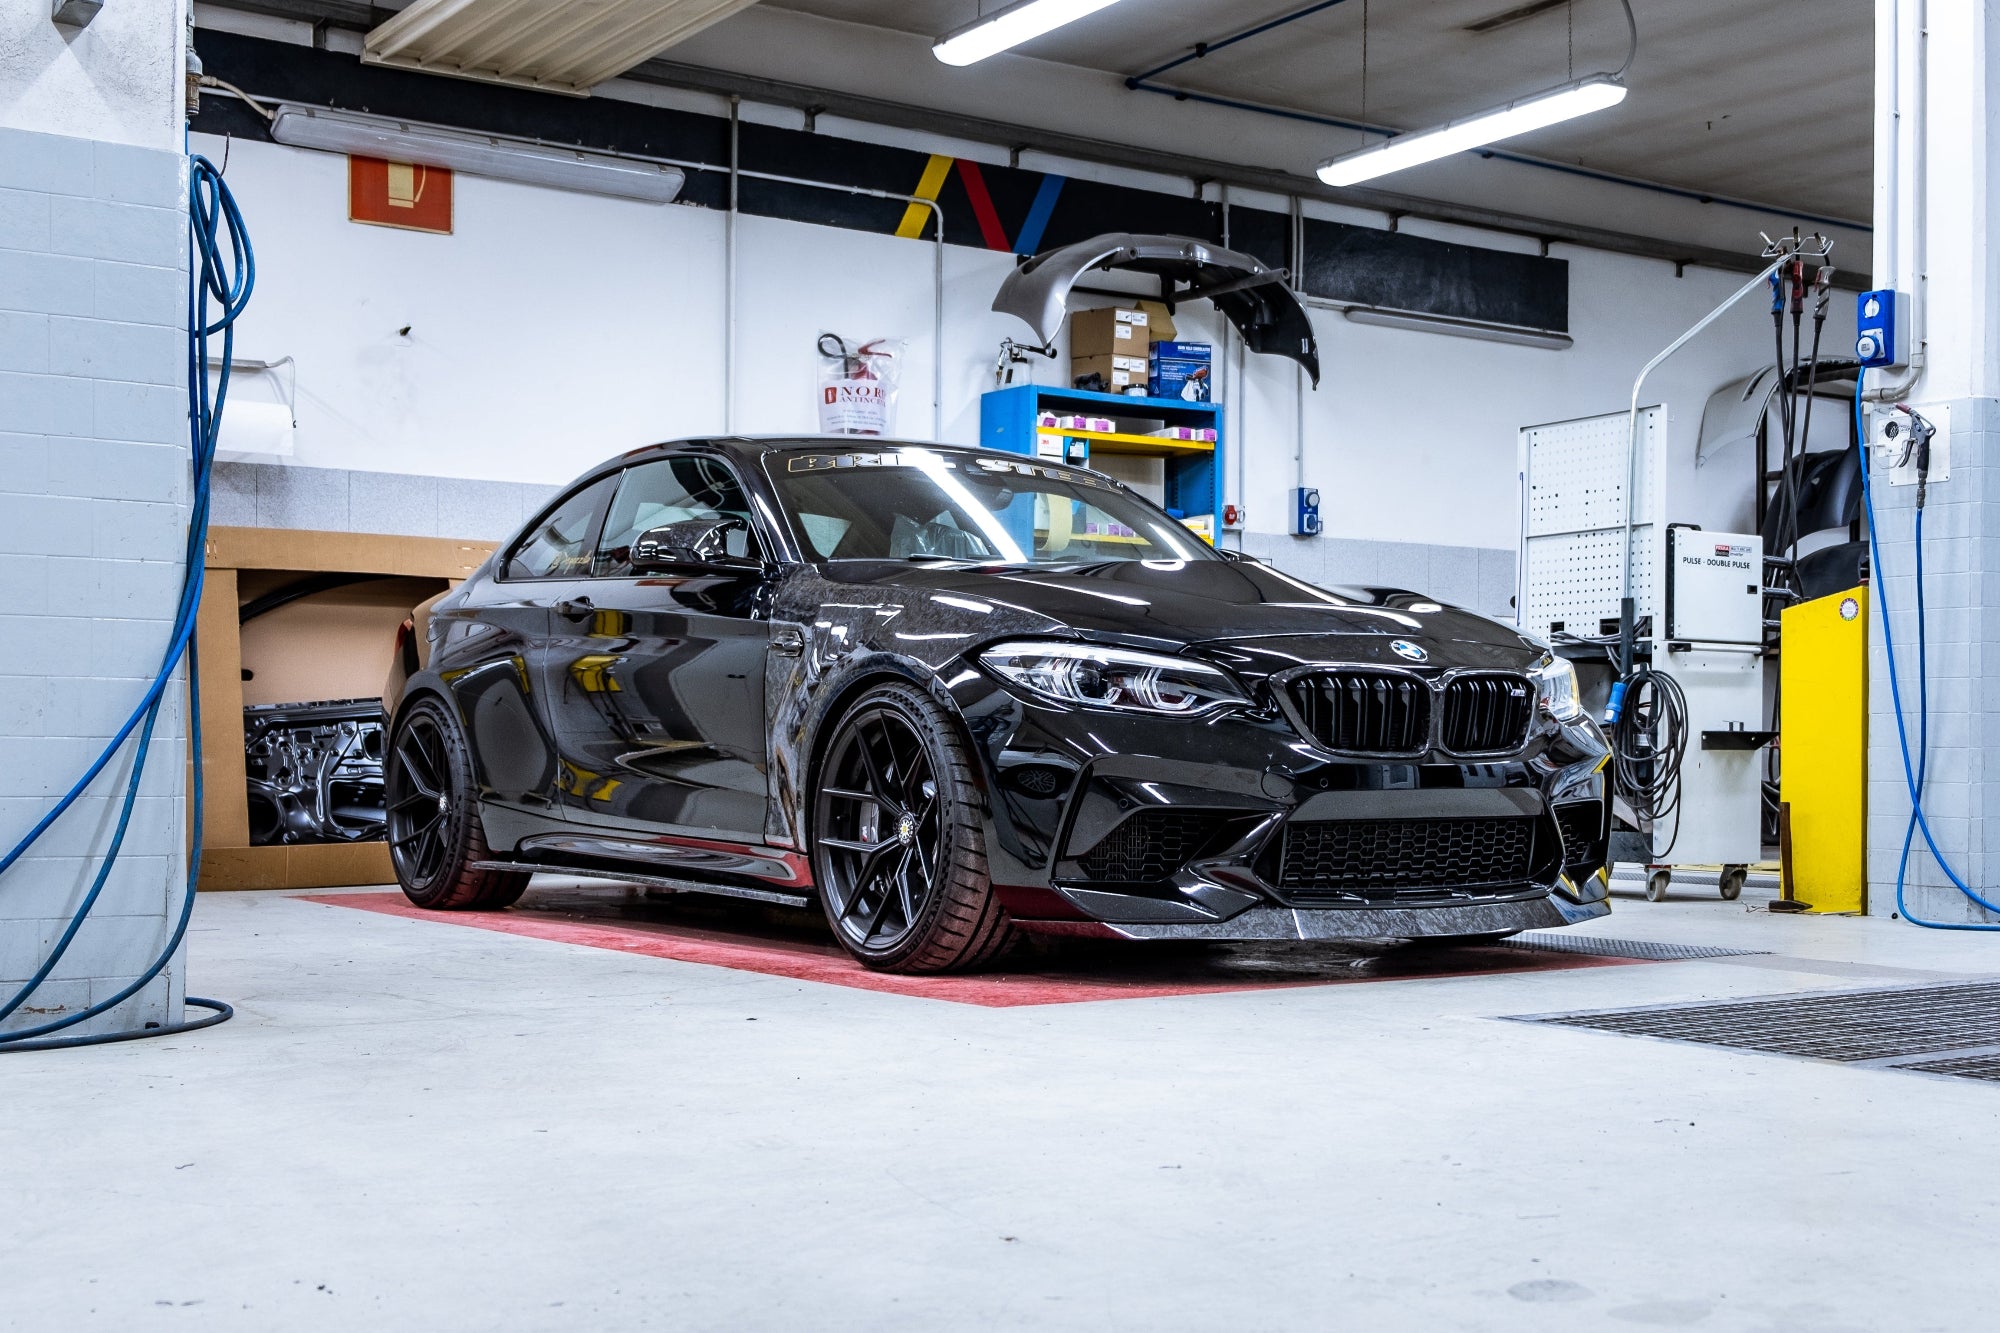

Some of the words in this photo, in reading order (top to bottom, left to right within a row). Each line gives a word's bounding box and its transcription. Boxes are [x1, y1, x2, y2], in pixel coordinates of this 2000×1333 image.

[1683, 557, 1702, 565] PULSE
[1707, 559, 1730, 567] DOUBLE
[1732, 561, 1750, 569] PULSE
